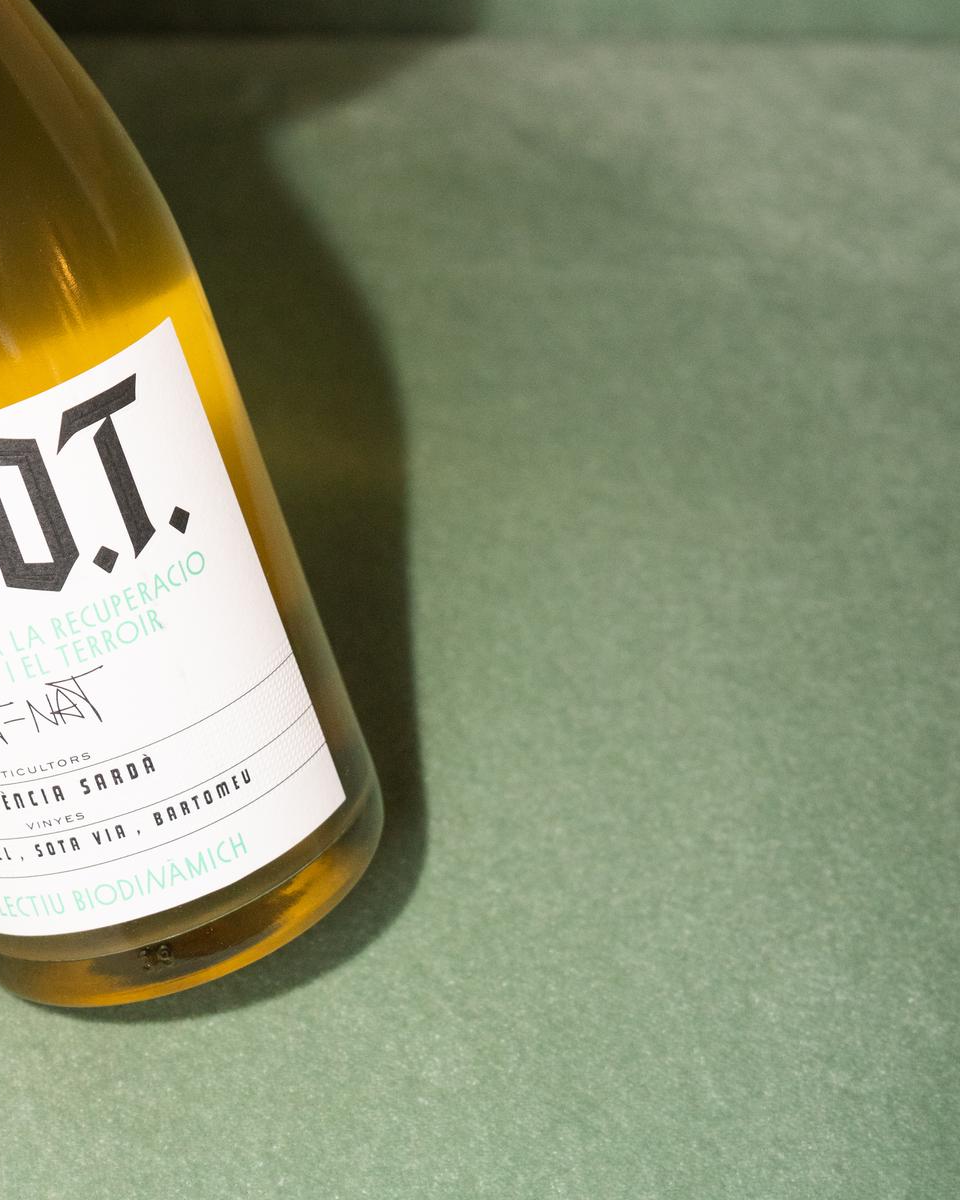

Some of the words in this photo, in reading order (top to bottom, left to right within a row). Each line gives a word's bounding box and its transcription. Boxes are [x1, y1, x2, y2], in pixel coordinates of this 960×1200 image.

[9, 624, 45, 652] LA
[50, 551, 205, 639] RECUPERACIO
[6, 662, 15, 683] I
[21, 653, 50, 679] EL
[56, 610, 164, 667] TERROIR
[80, 754, 156, 795] SARDÀ
[26, 812, 85, 830] VINYES
[34, 837, 80, 857] SOTA
[153, 769, 252, 826] BARTOMEU
[72, 832, 248, 912] BIODINÀMICH
